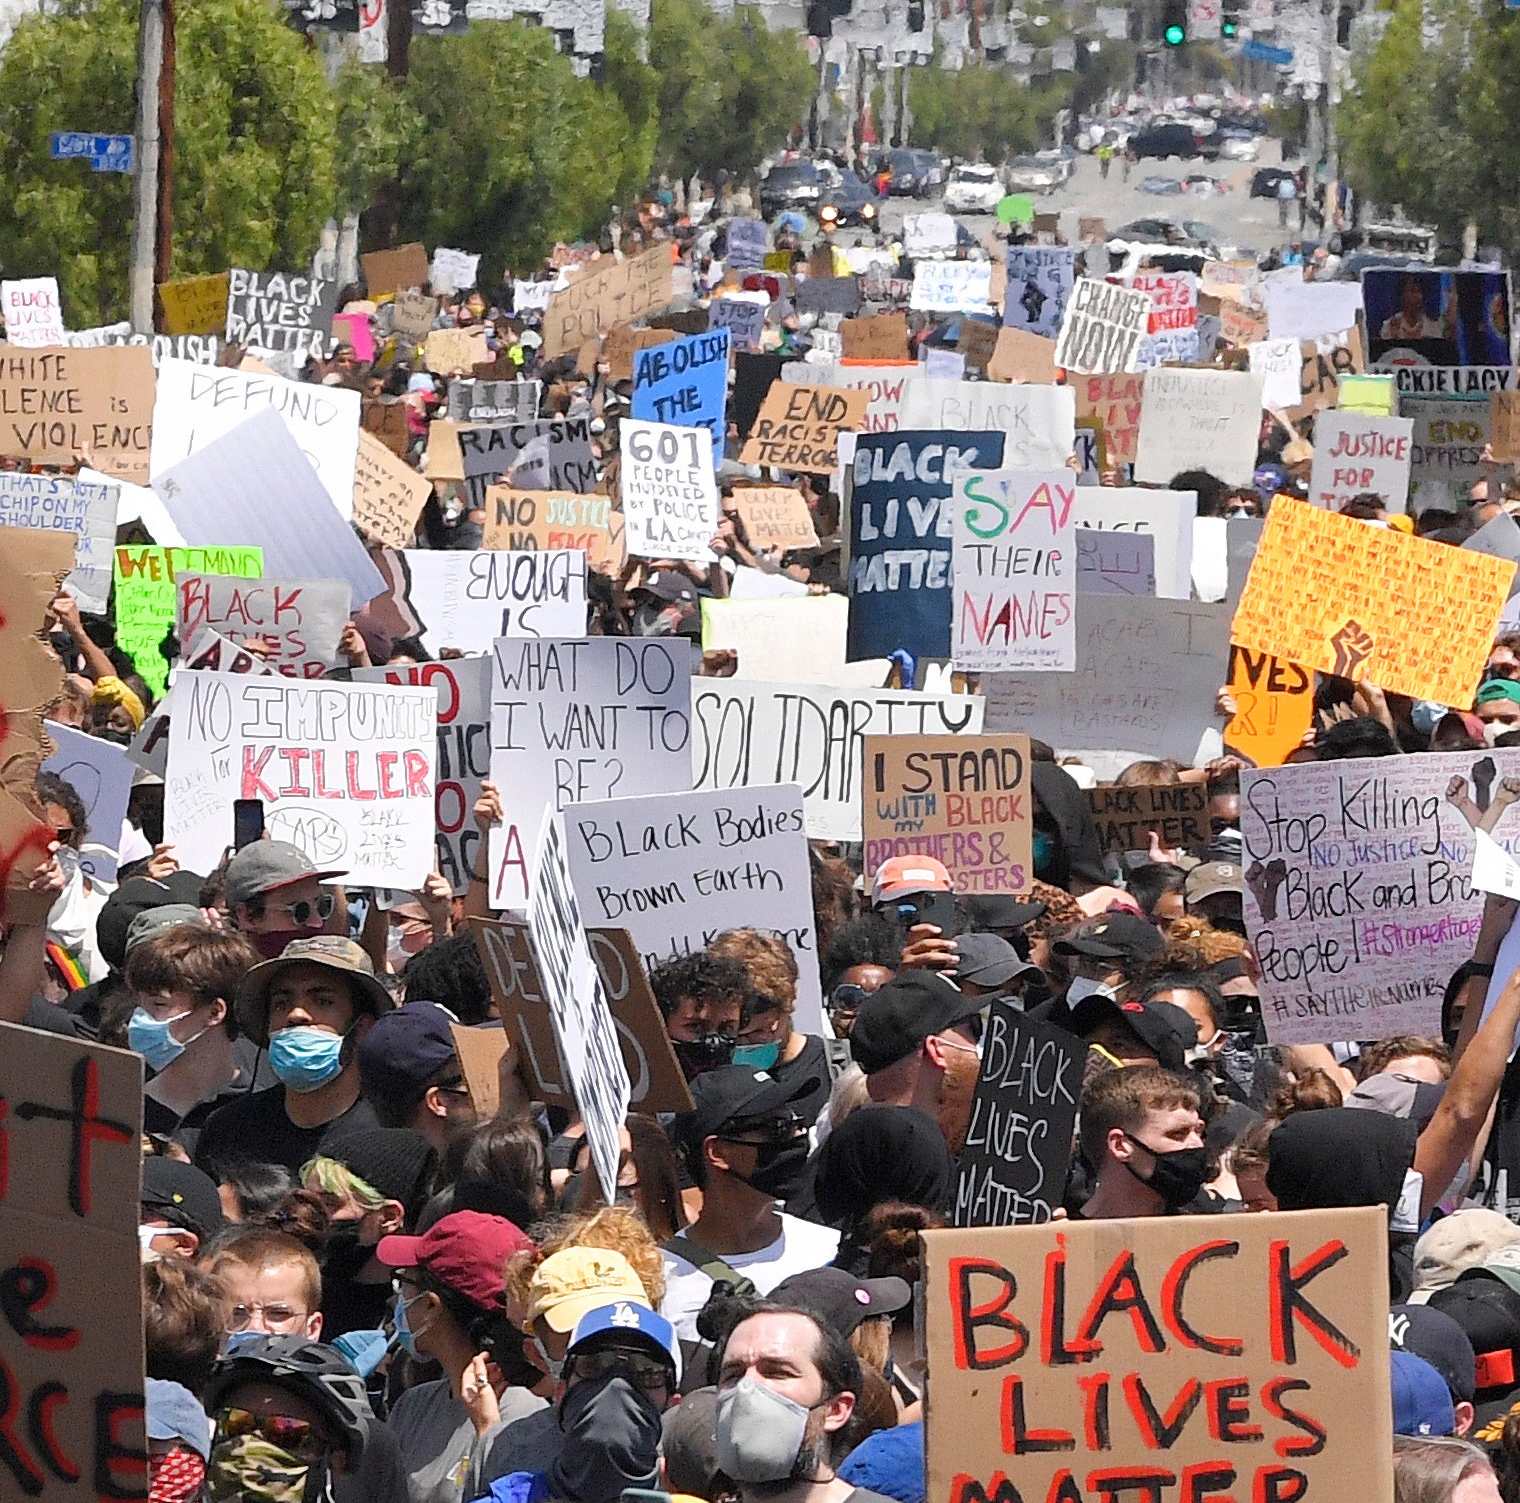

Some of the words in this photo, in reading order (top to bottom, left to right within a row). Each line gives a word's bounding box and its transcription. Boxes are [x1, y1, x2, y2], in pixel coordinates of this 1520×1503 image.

[229, 296, 312, 326] LIVES
[230, 269, 326, 307] BLACK
[635, 334, 728, 391] ABOLISH
[110, 396, 129, 414] is
[190, 372, 337, 426] DEFUND
[652, 386, 702, 422] THE
[785, 388, 848, 422] END
[629, 430, 700, 469] 601
[759, 420, 842, 443] RACIST
[1330, 430, 1408, 461] JUSTICE
[633, 464, 699, 486] PEOPLE
[854, 441, 979, 488] BLACK
[1333, 469, 1374, 487] FOR
[0, 496, 39, 510] CHIP
[42, 497, 66, 512] ON
[963, 476, 1076, 539] SAY
[117, 549, 161, 581] WE
[466, 551, 589, 602] ENOUGH
[962, 544, 1063, 578] THEIR
[181, 578, 302, 633] BLACK
[960, 590, 1071, 646] NAMES
[494, 642, 590, 692] WHAT
[616, 642, 674, 696] DO
[188, 676, 232, 741] NO
[241, 686, 437, 742] IMPUNITY
[494, 702, 527, 750] I
[538, 701, 628, 751] WANT
[636, 706, 689, 752] TO
[241, 744, 433, 801] KILLER
[693, 693, 972, 803] SOLIDARITY
[875, 753, 884, 793] I
[902, 749, 1023, 793] STAND
[714, 807, 803, 847] Bodies
[877, 794, 936, 820] WITH
[946, 793, 1025, 828] BLACK
[1245, 778, 1326, 867] Stop
[1339, 776, 1442, 855] Killing
[867, 831, 985, 877] BROTHERS
[989, 831, 1010, 864] &
[597, 880, 685, 919] Brown
[693, 862, 784, 897] Earth
[1285, 866, 1365, 922] Black
[1373, 869, 1417, 910] and
[983, 1016, 1076, 1104] BLACK
[965, 1099, 1048, 1194] LIVES
[955, 1166, 1051, 1226] MATTER
[610, 1302, 640, 1328] LA
[949, 1234, 1362, 1369] BLACK
[1000, 1373, 1327, 1458] LIVES
